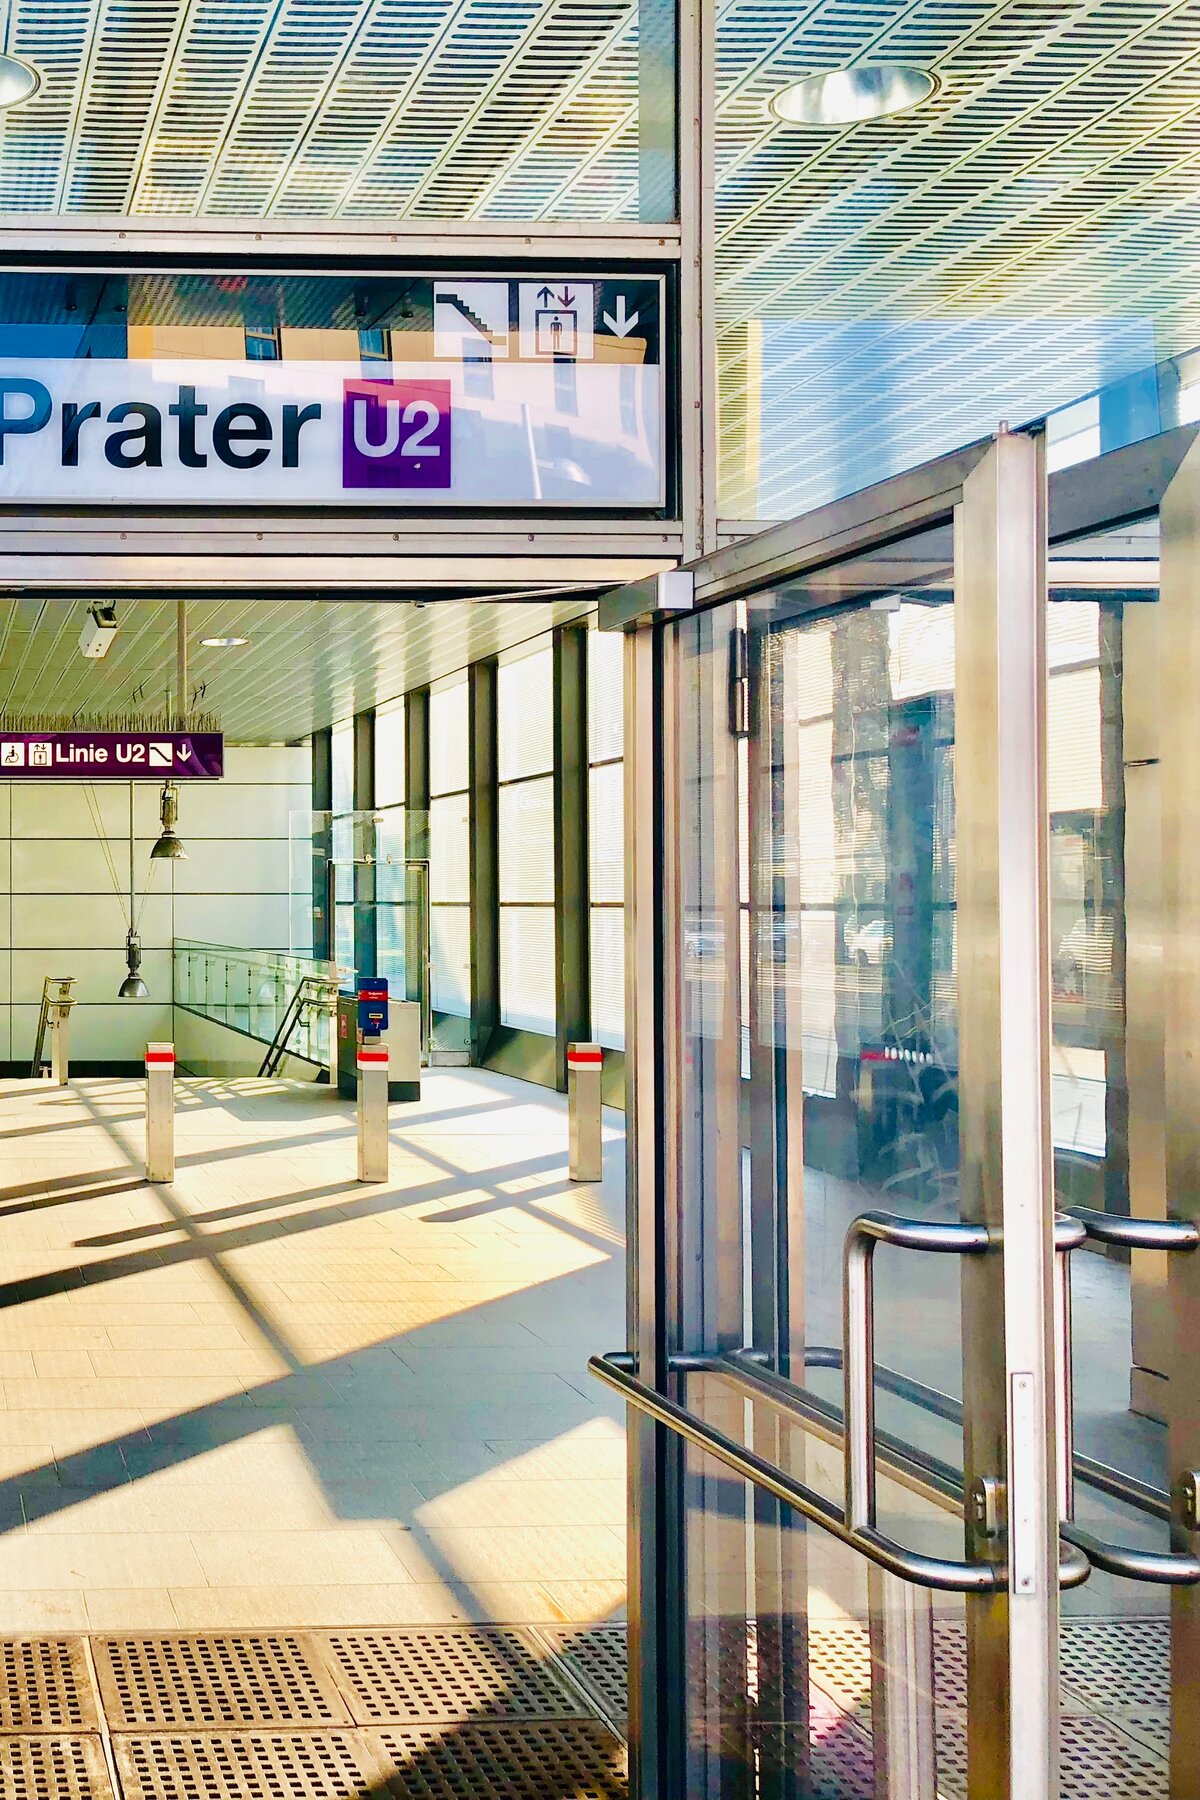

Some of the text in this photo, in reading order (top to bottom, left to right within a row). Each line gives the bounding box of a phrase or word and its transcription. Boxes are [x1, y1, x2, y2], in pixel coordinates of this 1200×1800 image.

[353, 399, 440, 458] U2
[56, 744, 146, 763] Linie U2
